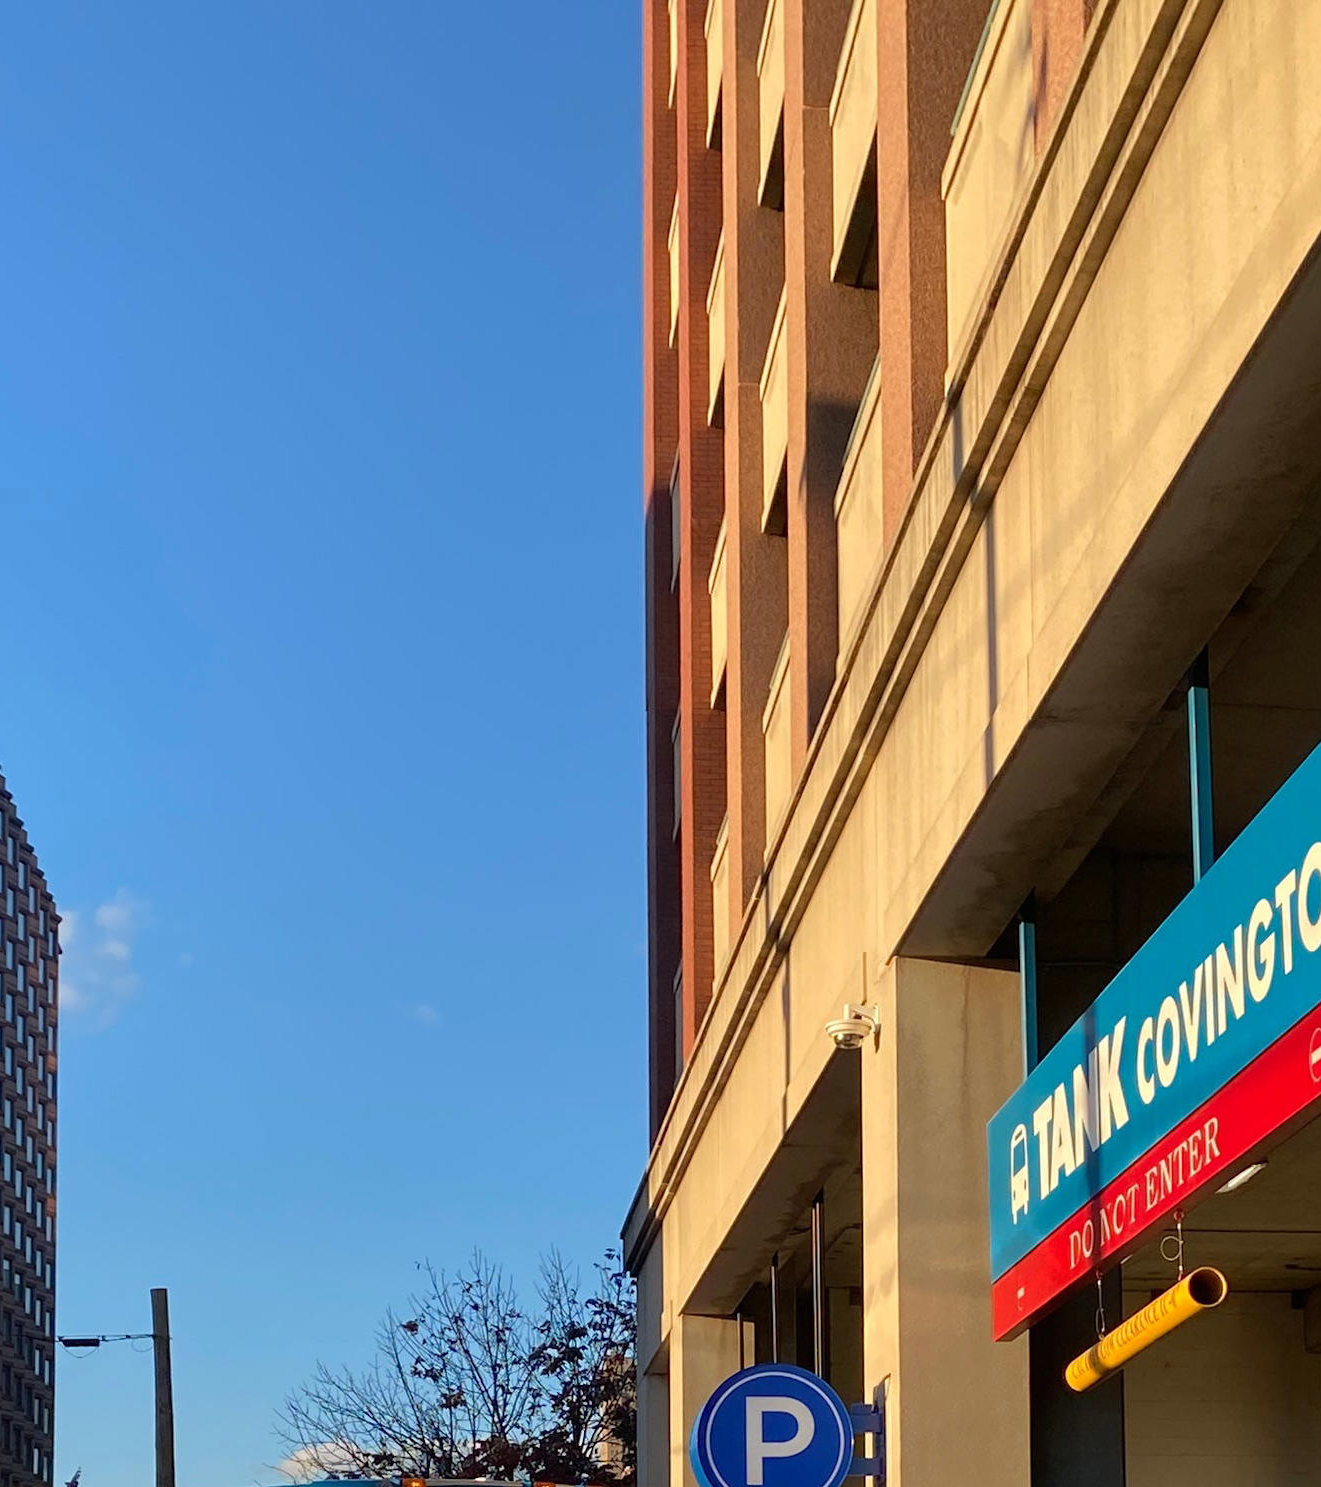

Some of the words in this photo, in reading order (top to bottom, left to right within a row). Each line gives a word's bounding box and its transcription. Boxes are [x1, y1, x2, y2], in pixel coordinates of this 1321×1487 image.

[1033, 1015, 1129, 1201] TANK
[1069, 1220, 1095, 1270] DO
[1100, 1183, 1139, 1247] NOT
[1145, 1116, 1221, 1210] ENTER
[746, 1396, 815, 1486] P
